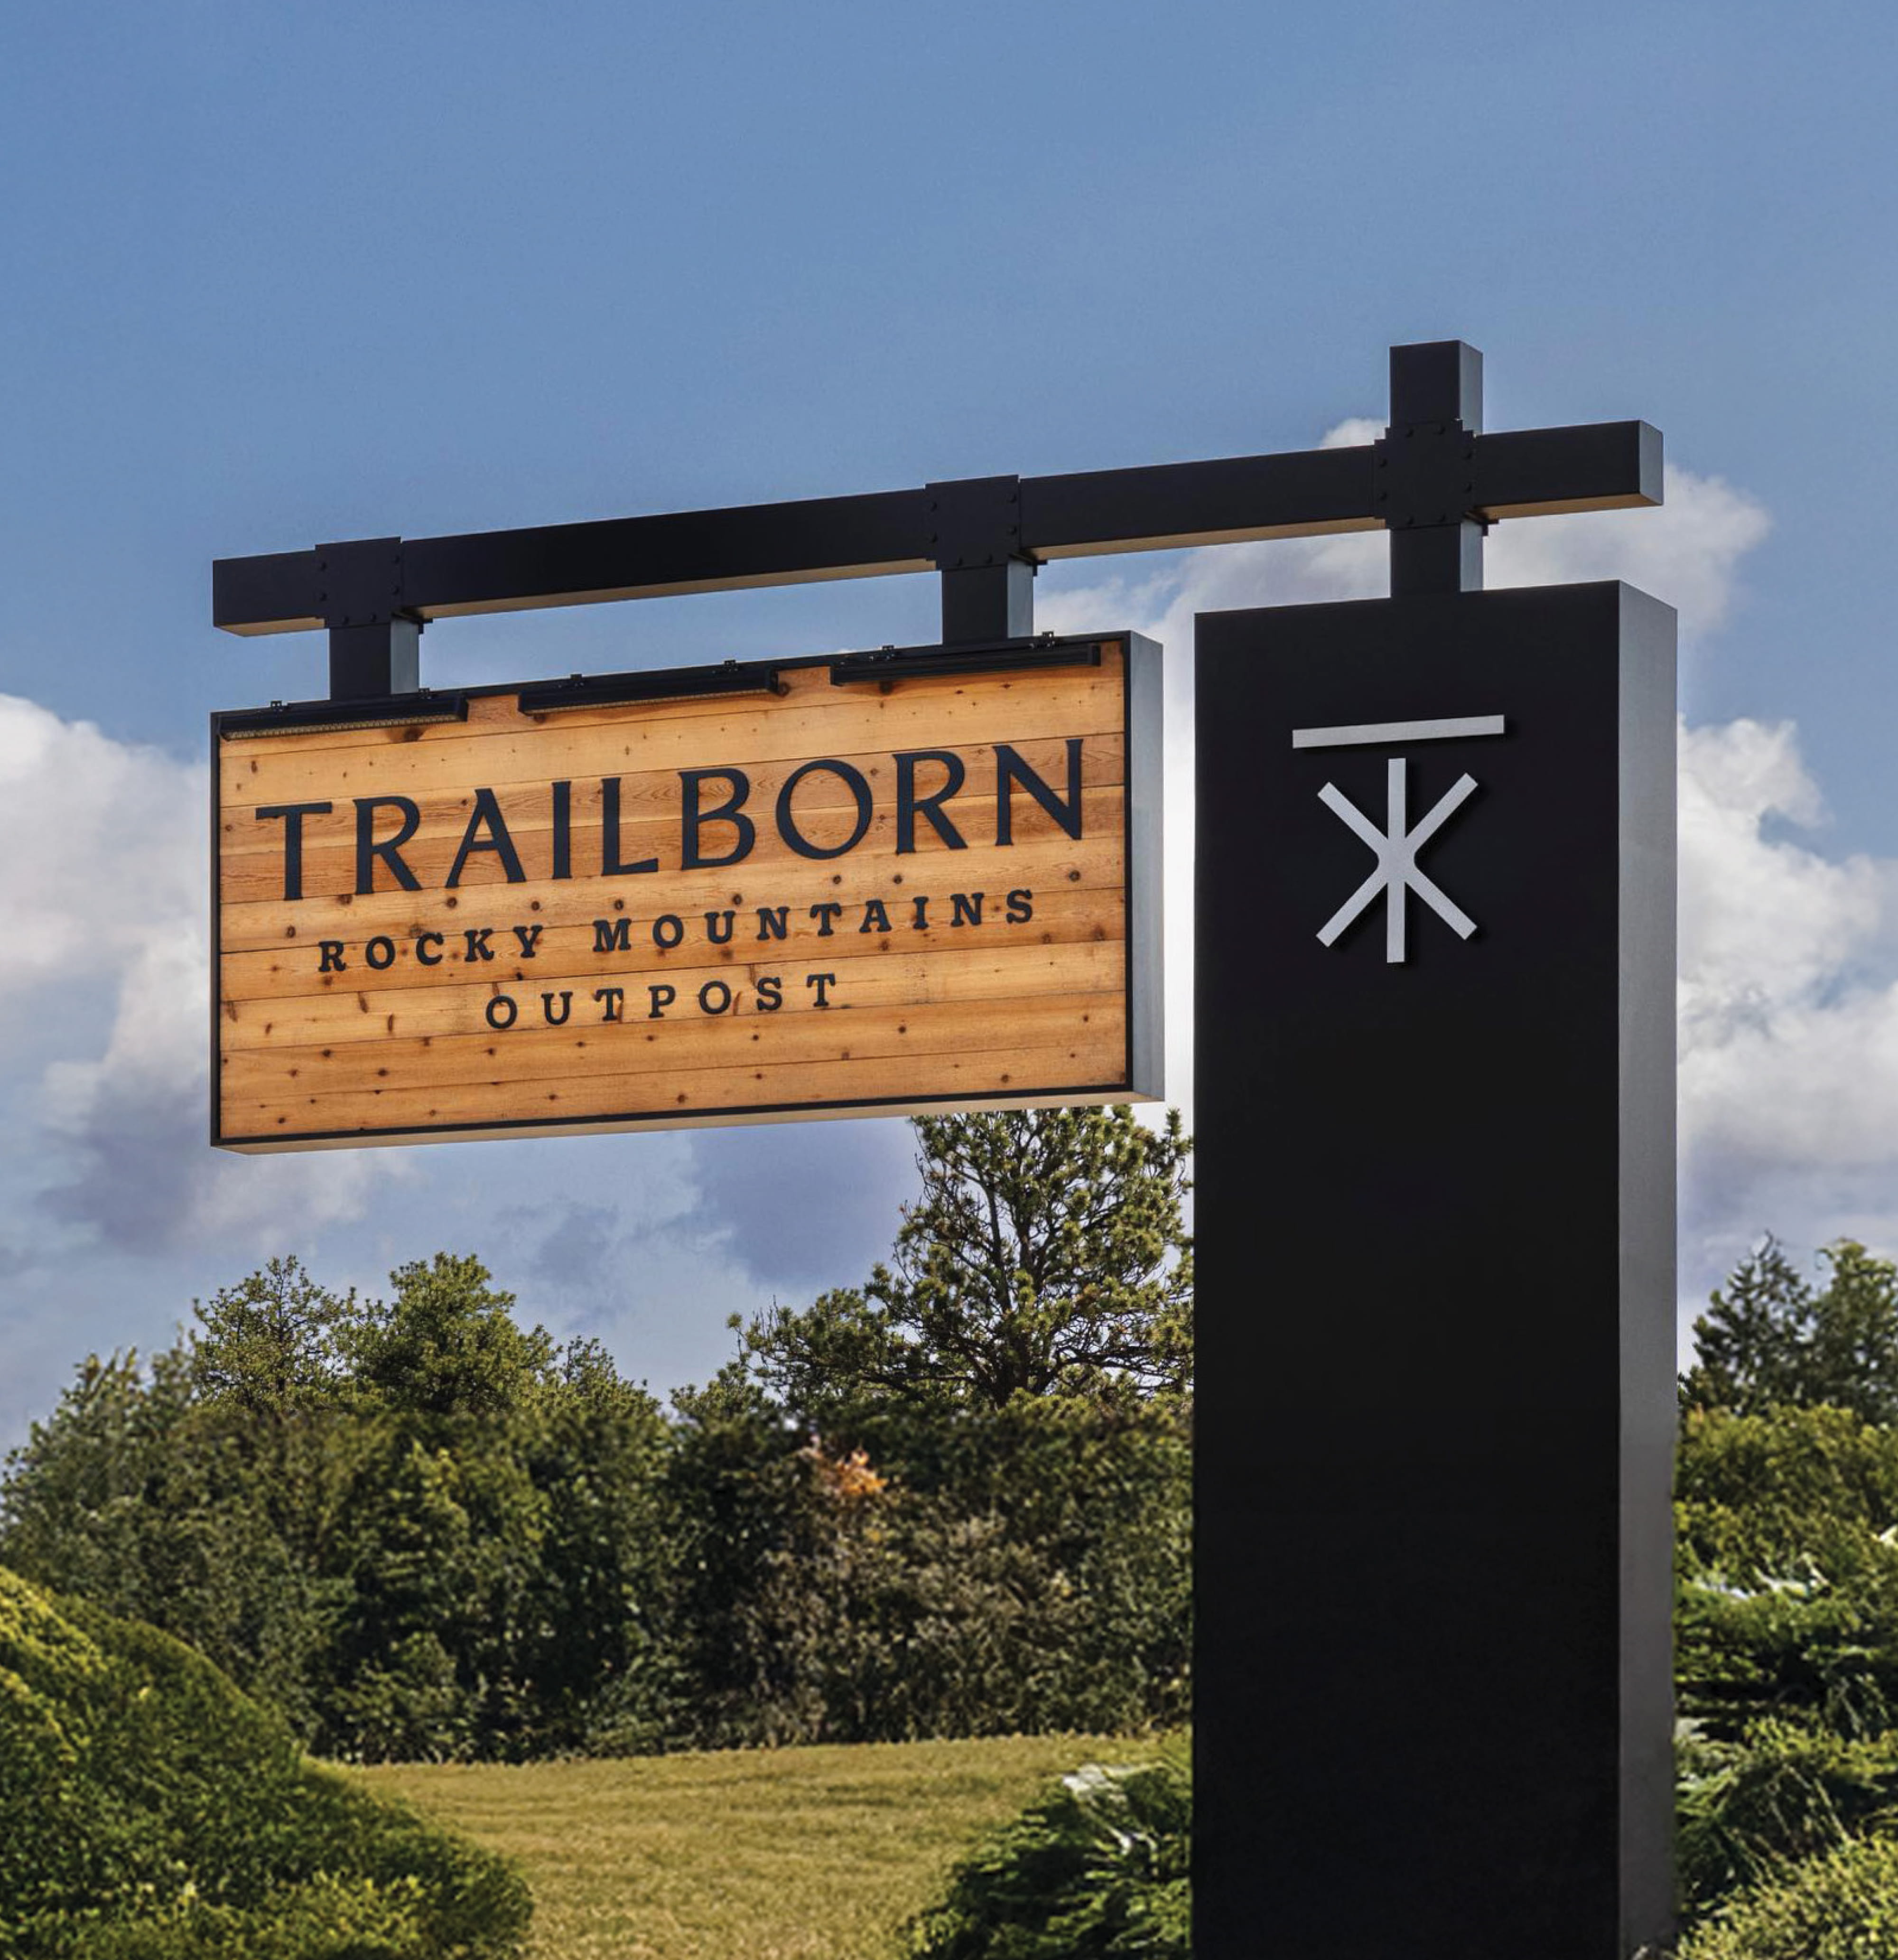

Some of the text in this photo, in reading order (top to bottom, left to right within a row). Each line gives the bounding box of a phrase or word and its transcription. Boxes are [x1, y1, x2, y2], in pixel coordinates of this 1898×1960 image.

[255, 738, 1088, 902] TRAILBORN
[318, 889, 1033, 973] ROCKY MOUNTAINS
[485, 973, 837, 1030] OUTPOST
